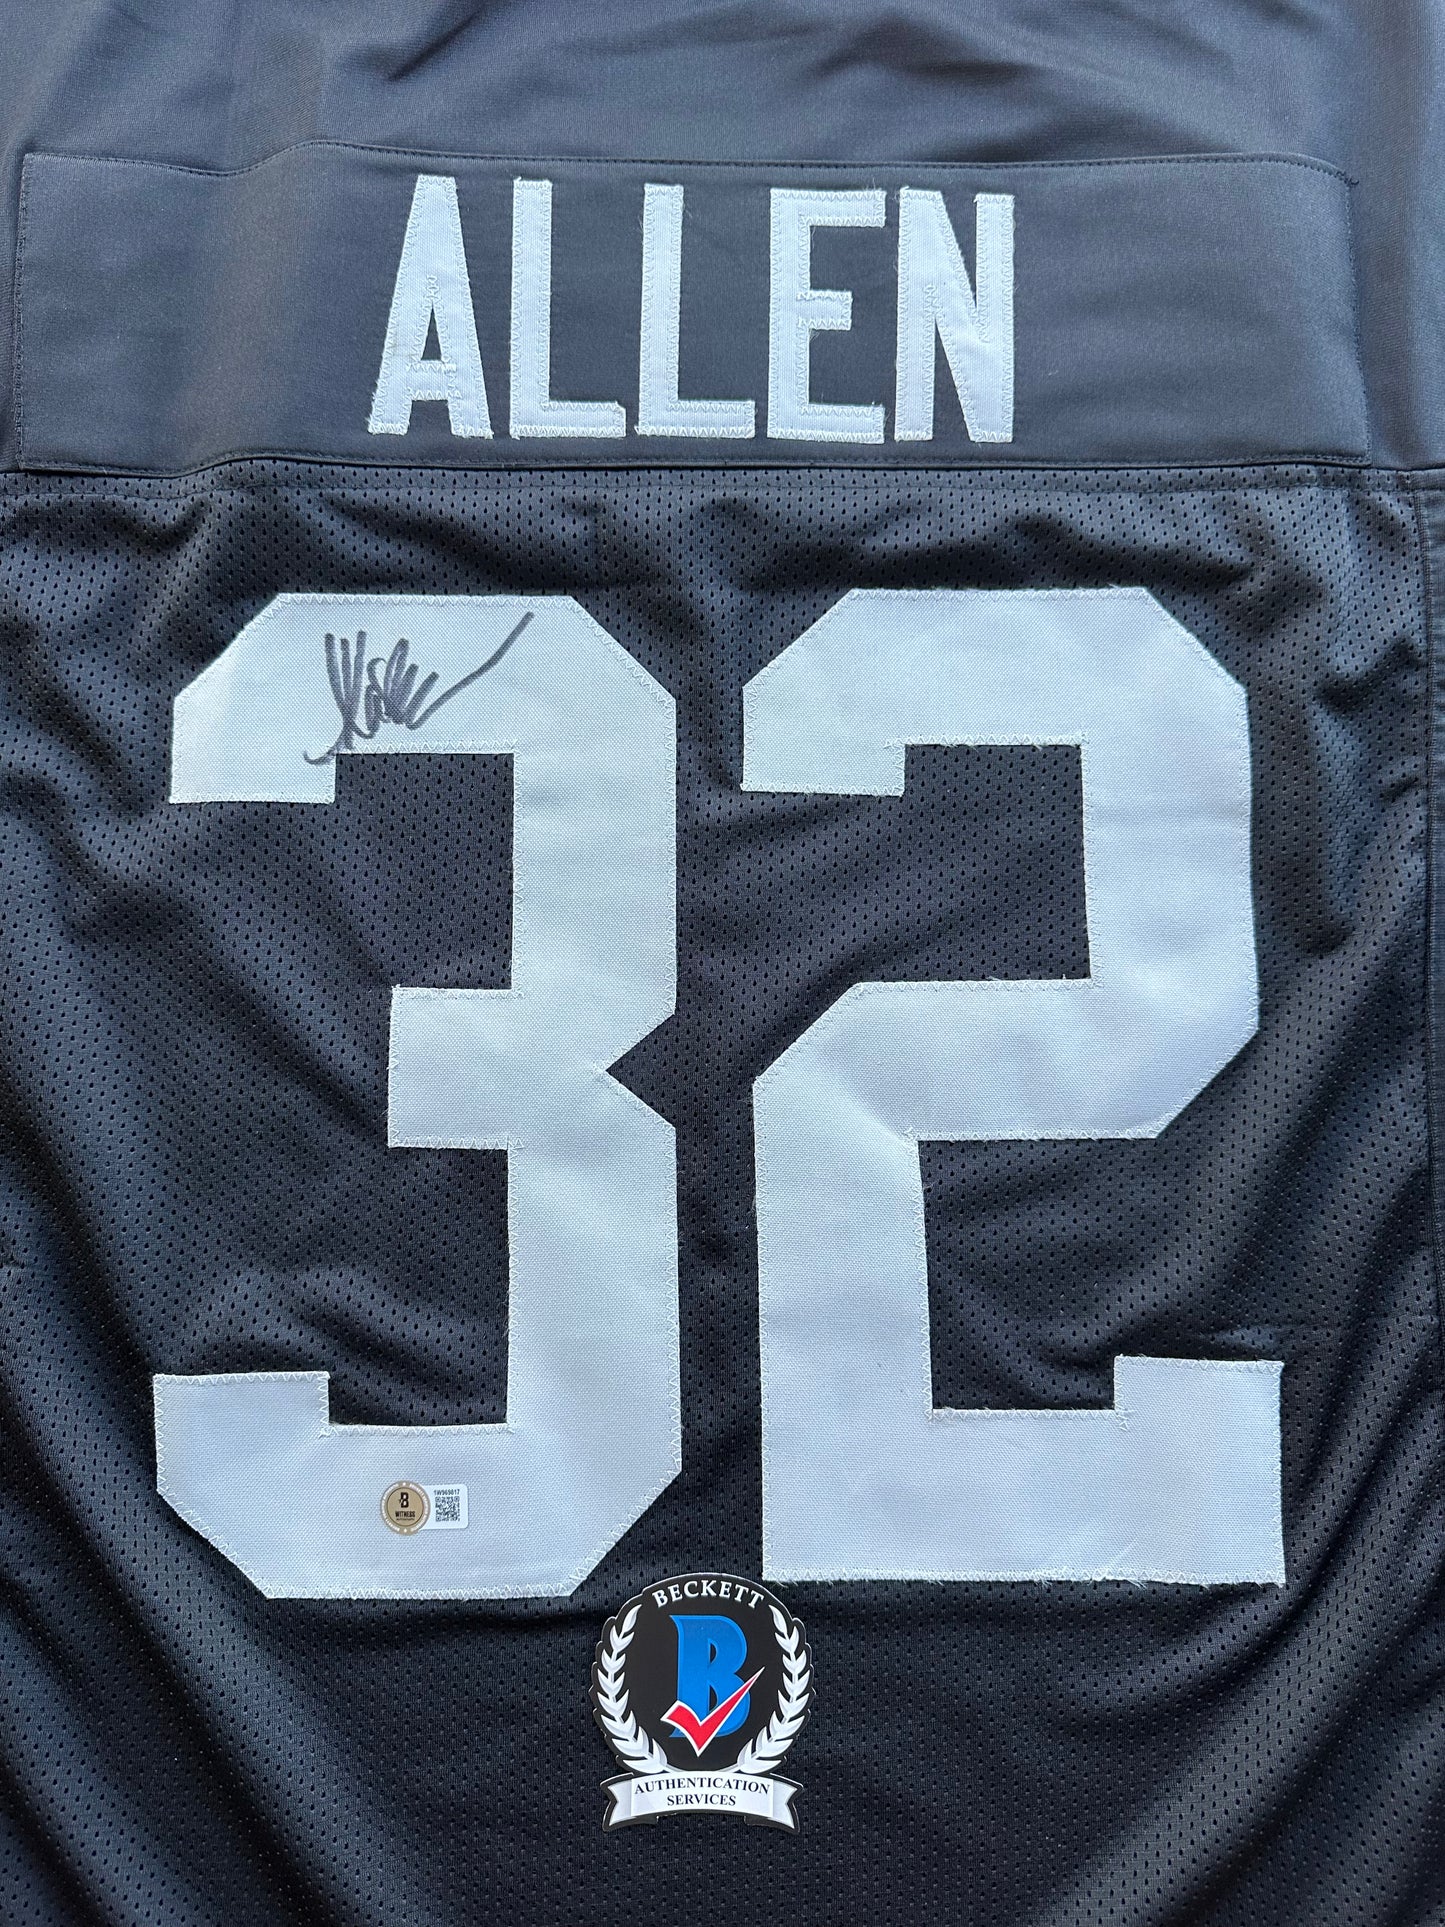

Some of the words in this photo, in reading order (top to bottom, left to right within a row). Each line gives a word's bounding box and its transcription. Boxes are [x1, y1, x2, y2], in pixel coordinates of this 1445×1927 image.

[368, 174, 1015, 444] ALLEN
[153, 586, 1285, 1600] 32
[651, 1579, 764, 1609] BECKETT
[634, 1776, 770, 1795] AUTHENTICATION
[667, 1794, 737, 1807] SERVICES
